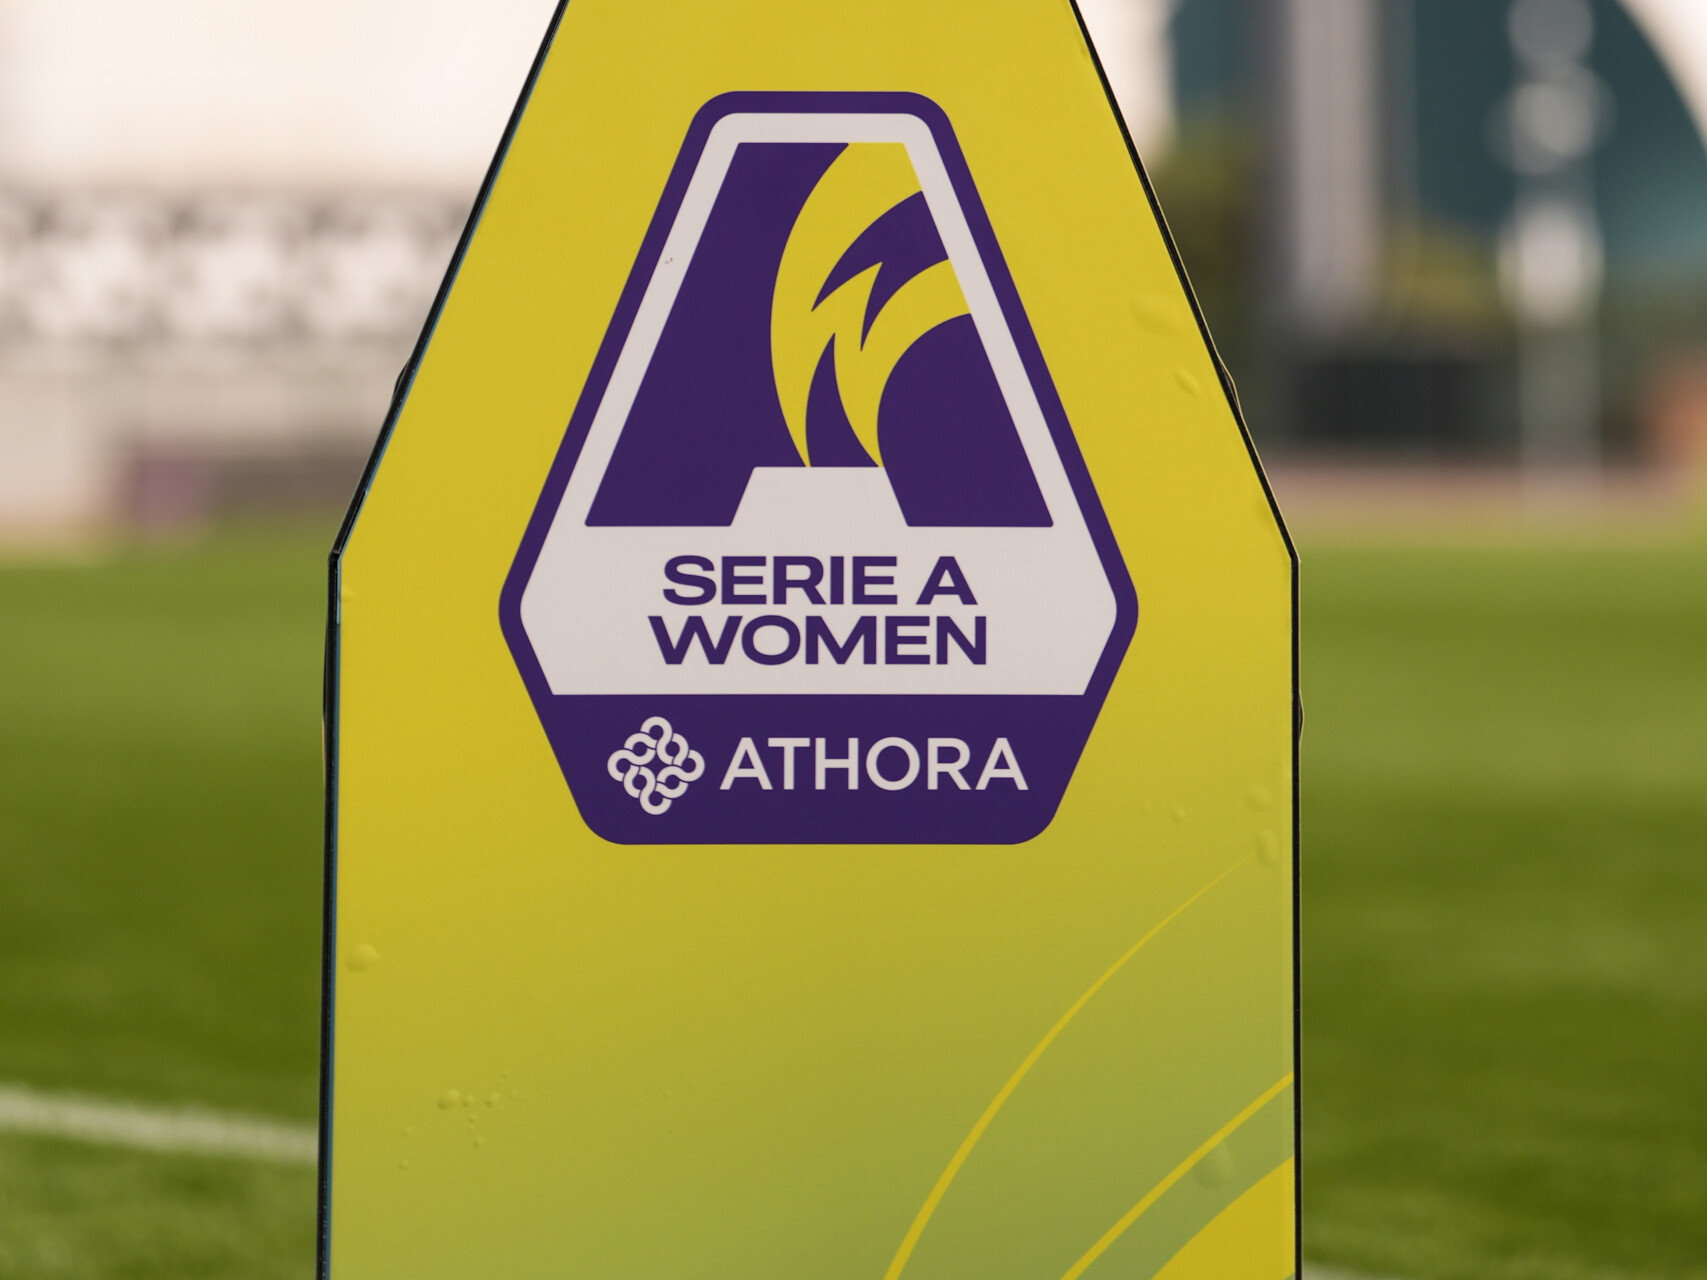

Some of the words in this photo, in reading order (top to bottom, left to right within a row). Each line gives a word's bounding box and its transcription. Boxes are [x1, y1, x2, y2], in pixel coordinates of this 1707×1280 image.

[662, 554, 898, 606] SERIE
[915, 555, 978, 605] A
[647, 614, 987, 666] WOMEN
[719, 736, 1030, 791] ATHORA
